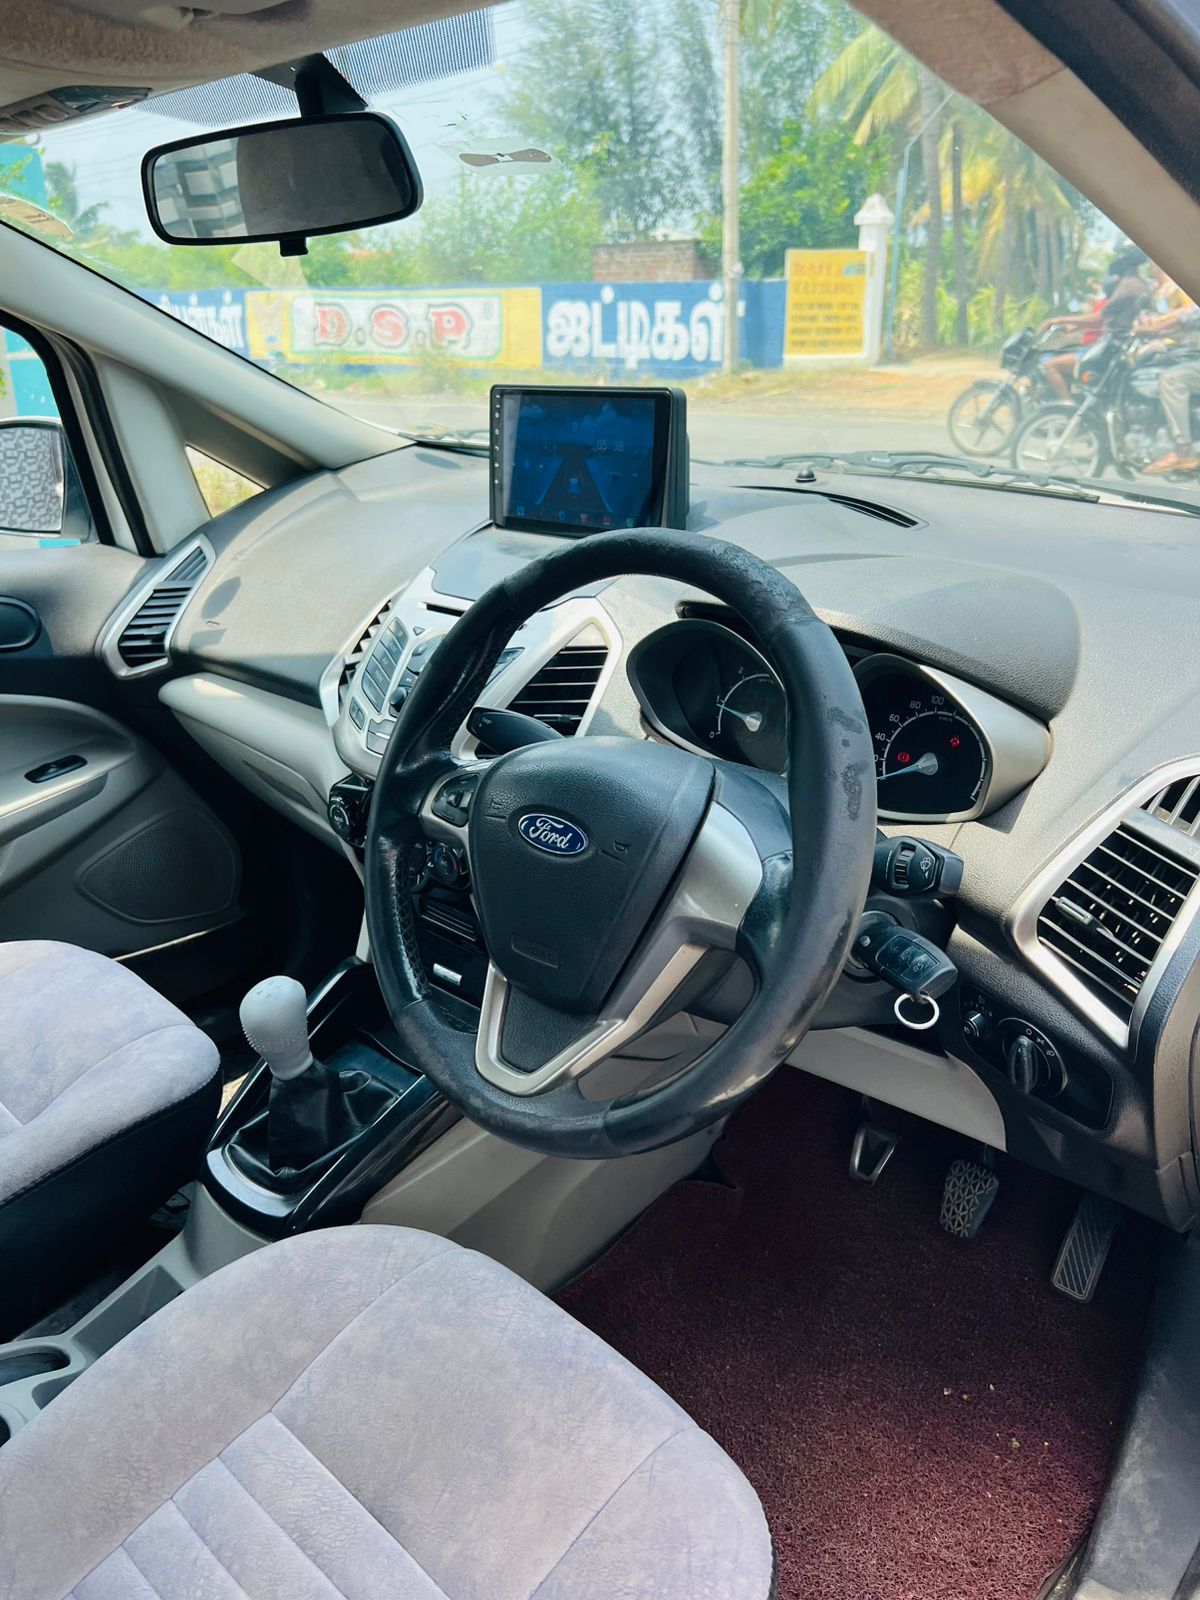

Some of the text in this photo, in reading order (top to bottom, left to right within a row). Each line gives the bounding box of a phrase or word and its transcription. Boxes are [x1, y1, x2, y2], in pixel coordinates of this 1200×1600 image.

[313, 302, 474, 349] D.S.P
[546, 283, 746, 369] ஜட்டிகள்
[738, 666, 744, 674] 2
[909, 700, 921, 710] 80
[931, 695, 945, 705] 100
[888, 713, 900, 723] 60
[875, 731, 886, 741] 40
[528, 817, 574, 849] Ford
